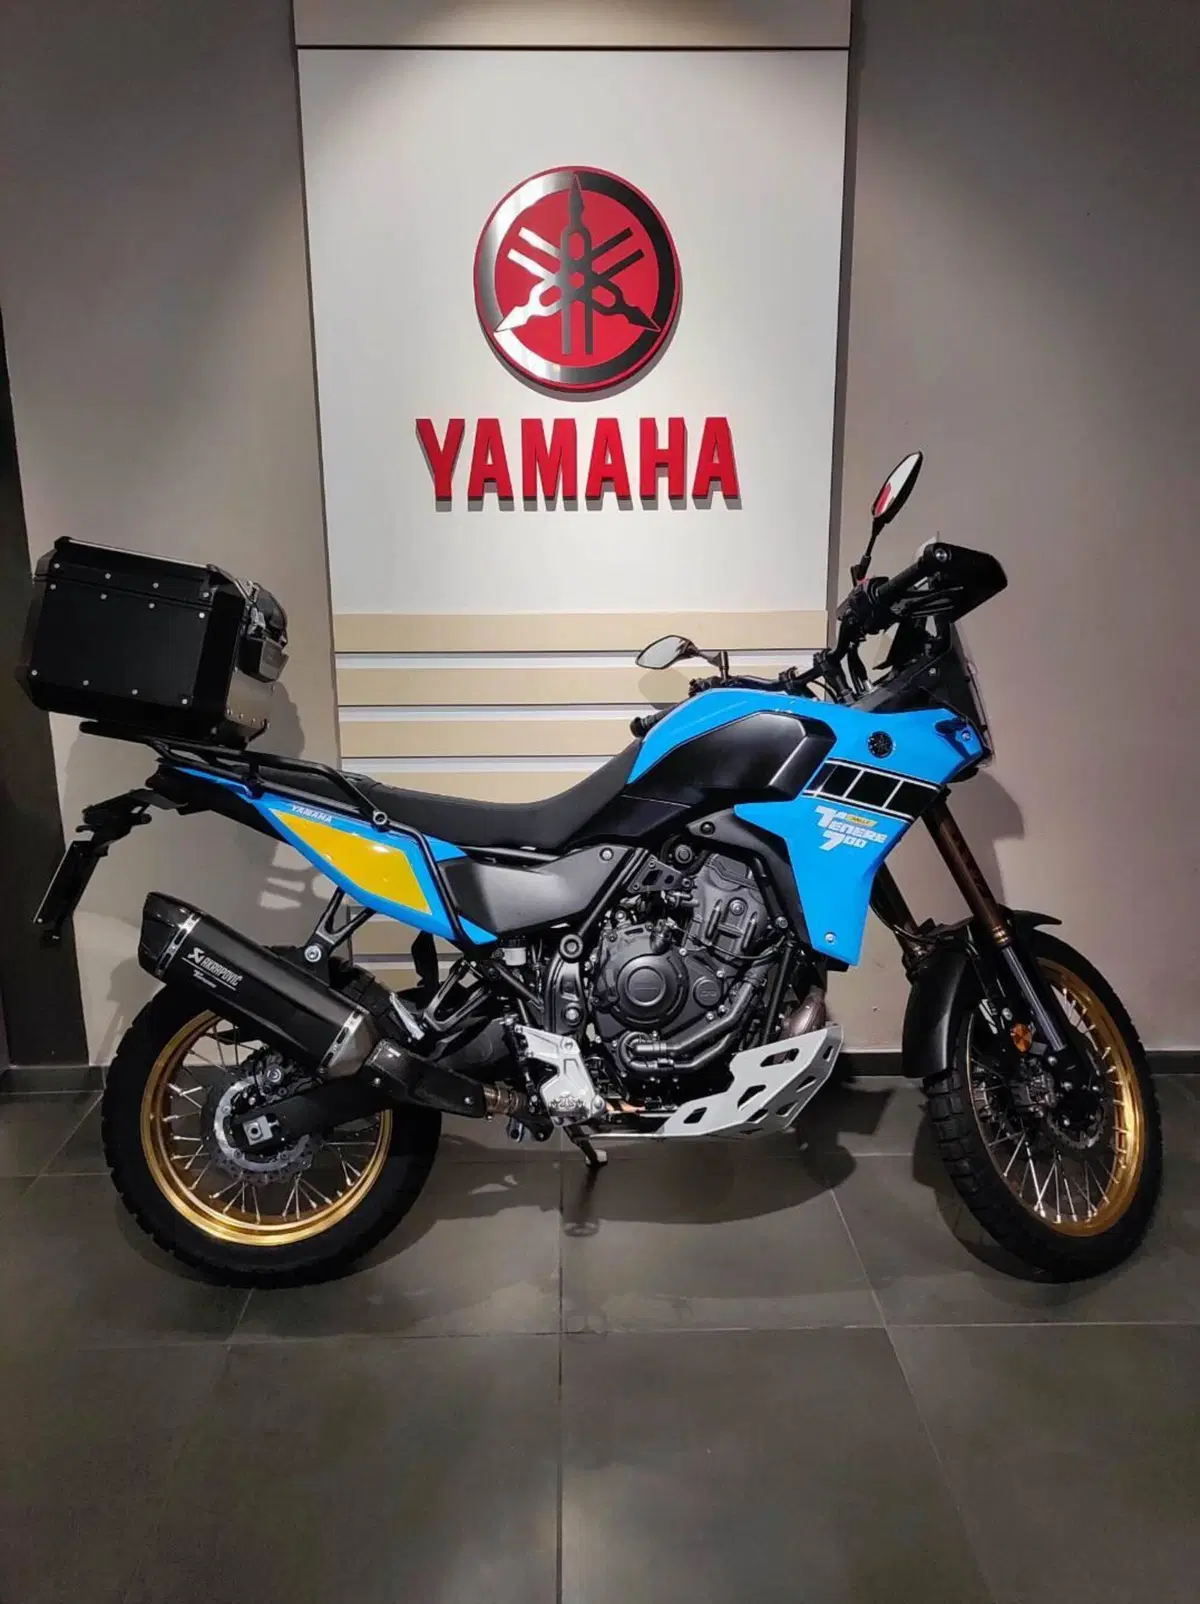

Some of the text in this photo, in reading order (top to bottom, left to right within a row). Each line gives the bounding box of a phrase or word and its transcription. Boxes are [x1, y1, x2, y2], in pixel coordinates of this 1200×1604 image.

[415, 417, 741, 500] YAMAHA
[292, 804, 332, 822] YAMAHA
[819, 829, 868, 851] 700
